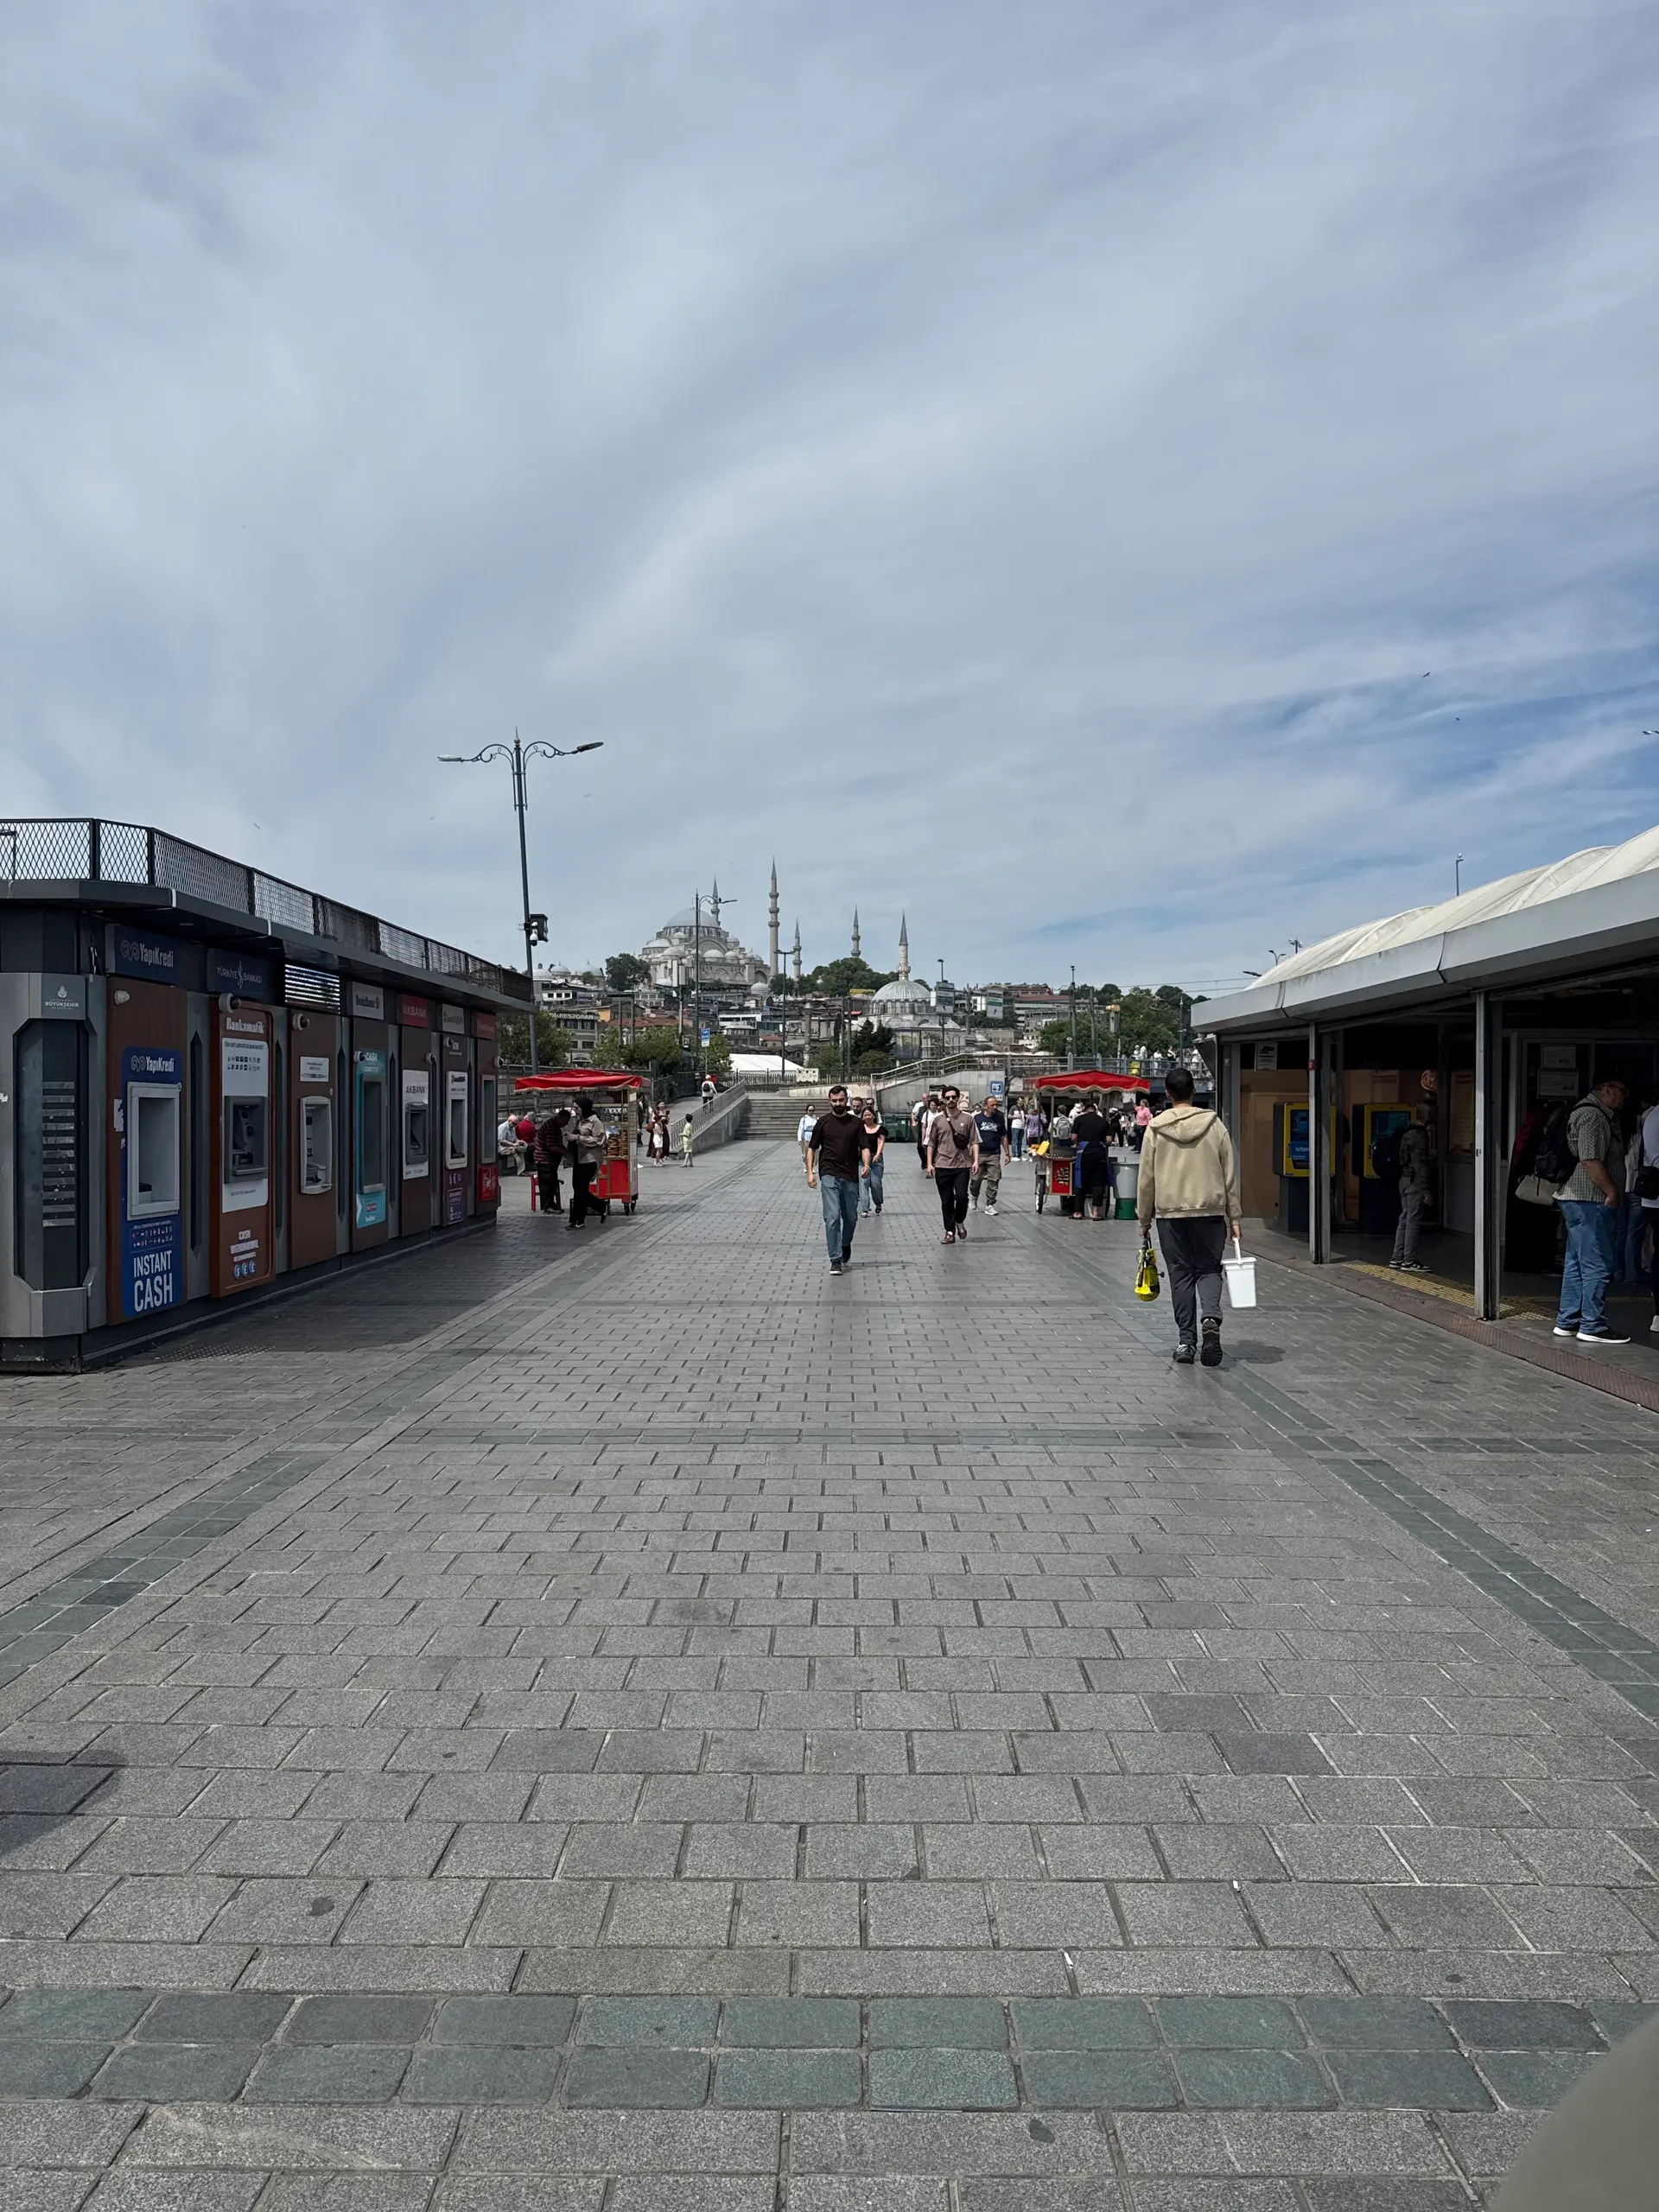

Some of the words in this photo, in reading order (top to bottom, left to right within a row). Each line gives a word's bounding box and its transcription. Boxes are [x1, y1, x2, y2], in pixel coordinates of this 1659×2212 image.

[403, 1005, 427, 1019] AKBANK
[226, 1017, 264, 1034] Bankamatik
[406, 1085, 425, 1094] AKBANK
[133, 1249, 172, 1278] INSTANT
[134, 1273, 173, 1313] CASH
